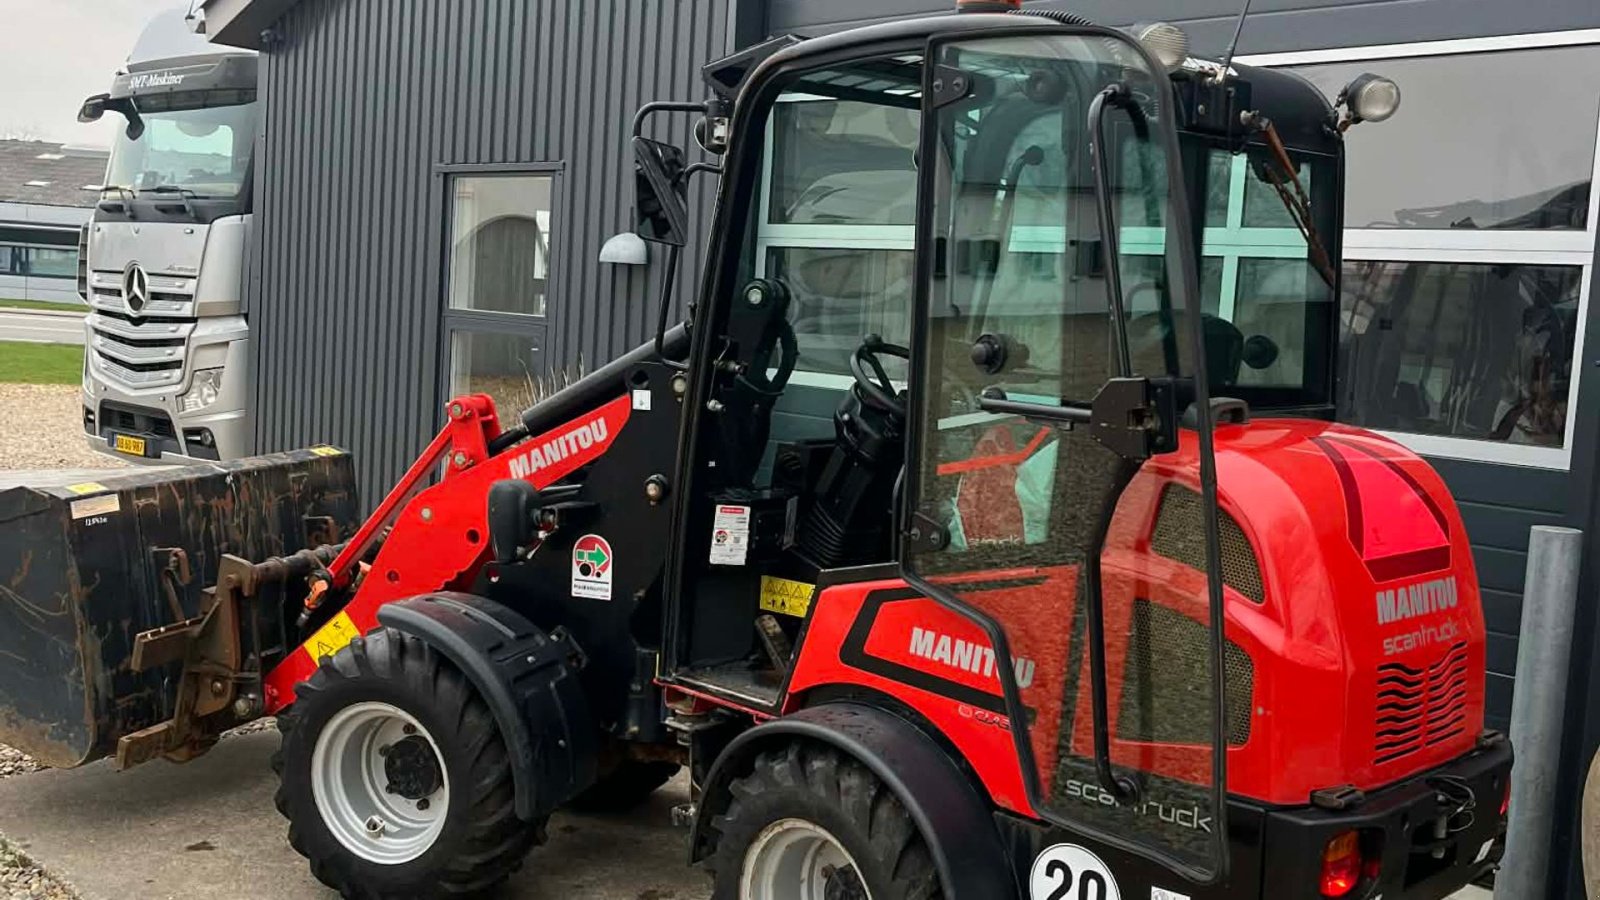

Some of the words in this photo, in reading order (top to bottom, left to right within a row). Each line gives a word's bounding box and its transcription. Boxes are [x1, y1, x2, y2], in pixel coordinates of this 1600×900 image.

[508, 416, 608, 479] MANITOU
[1376, 575, 1458, 625] MANITOU
[909, 626, 1036, 689] MANITU
[1382, 616, 1459, 656] scantruck
[1066, 779, 1213, 833] scaruck
[1045, 859, 1107, 900] 20
